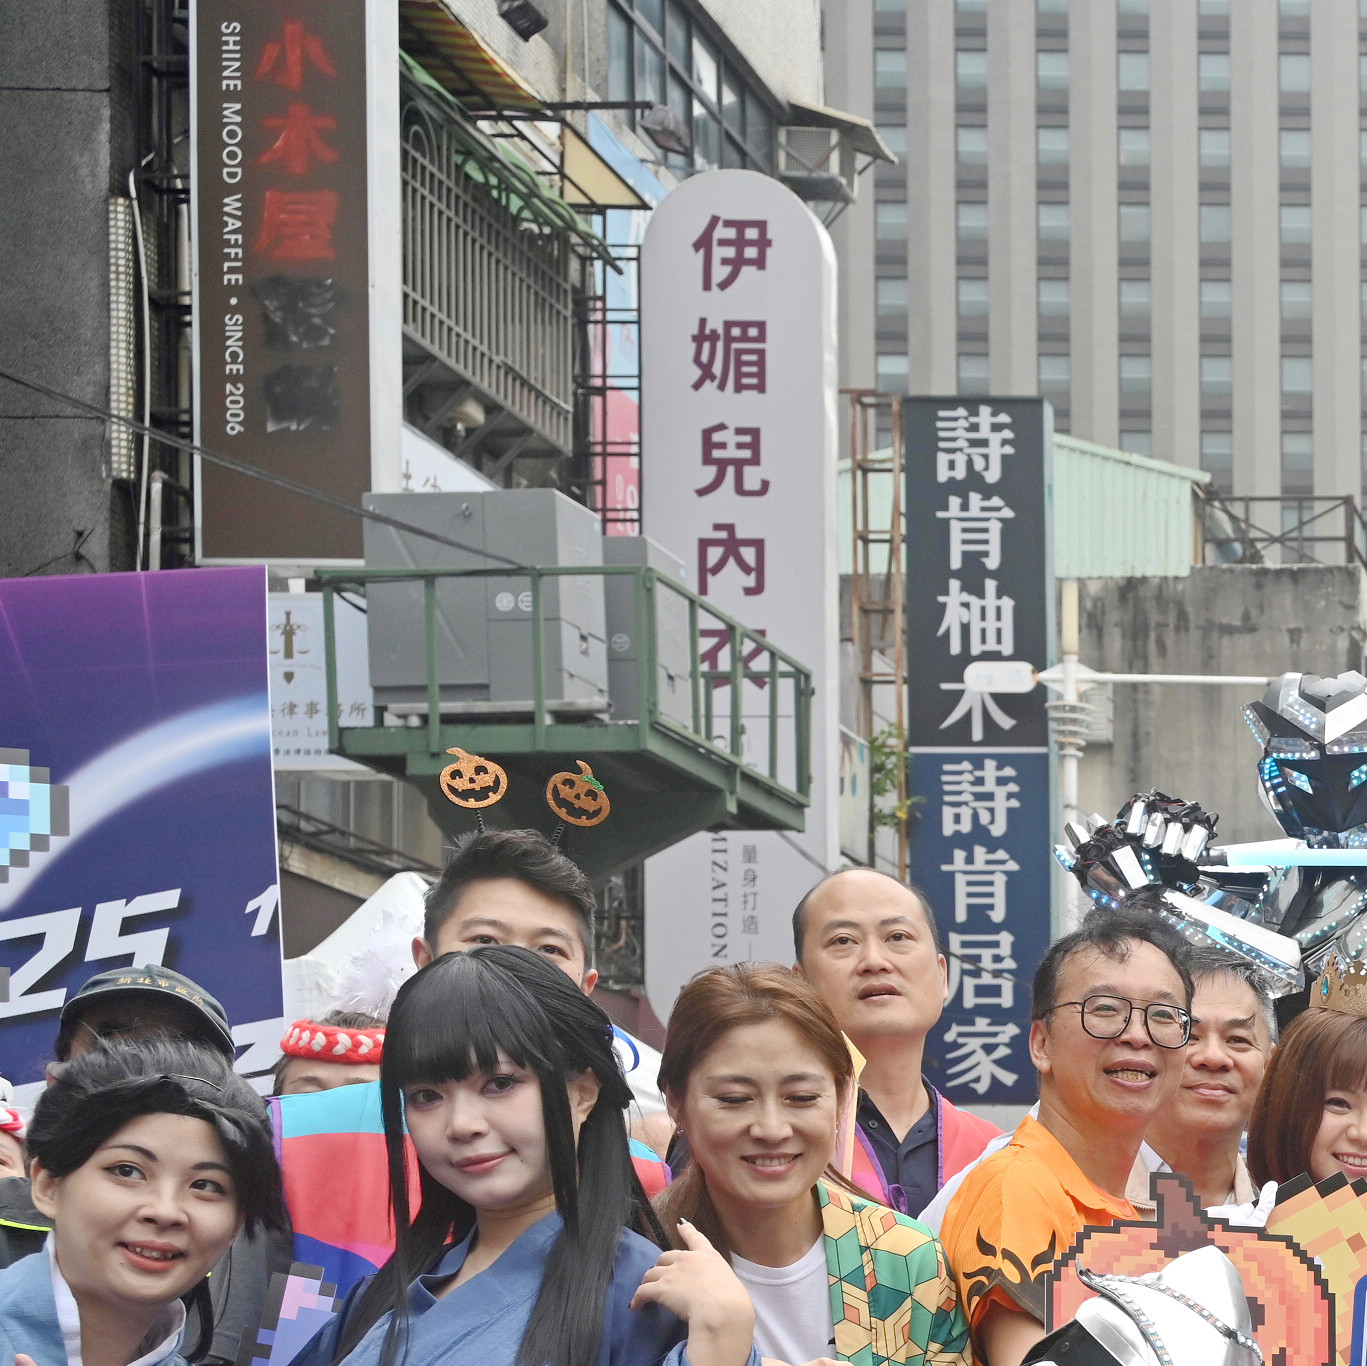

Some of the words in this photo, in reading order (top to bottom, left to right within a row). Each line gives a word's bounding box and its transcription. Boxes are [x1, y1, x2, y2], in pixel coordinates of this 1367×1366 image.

[221, 21, 241, 91] SHINE
[222, 102, 243, 185] MOOD
[222, 193, 243, 286] WAFFLE
[224, 313, 243, 376] SINCE
[225, 382, 245, 436] 2006
[691, 214, 773, 691] 伊媚兒內衣
[935, 404, 1016, 743] 詩肯柚木
[938, 758, 1022, 1095] 詩肯居家
